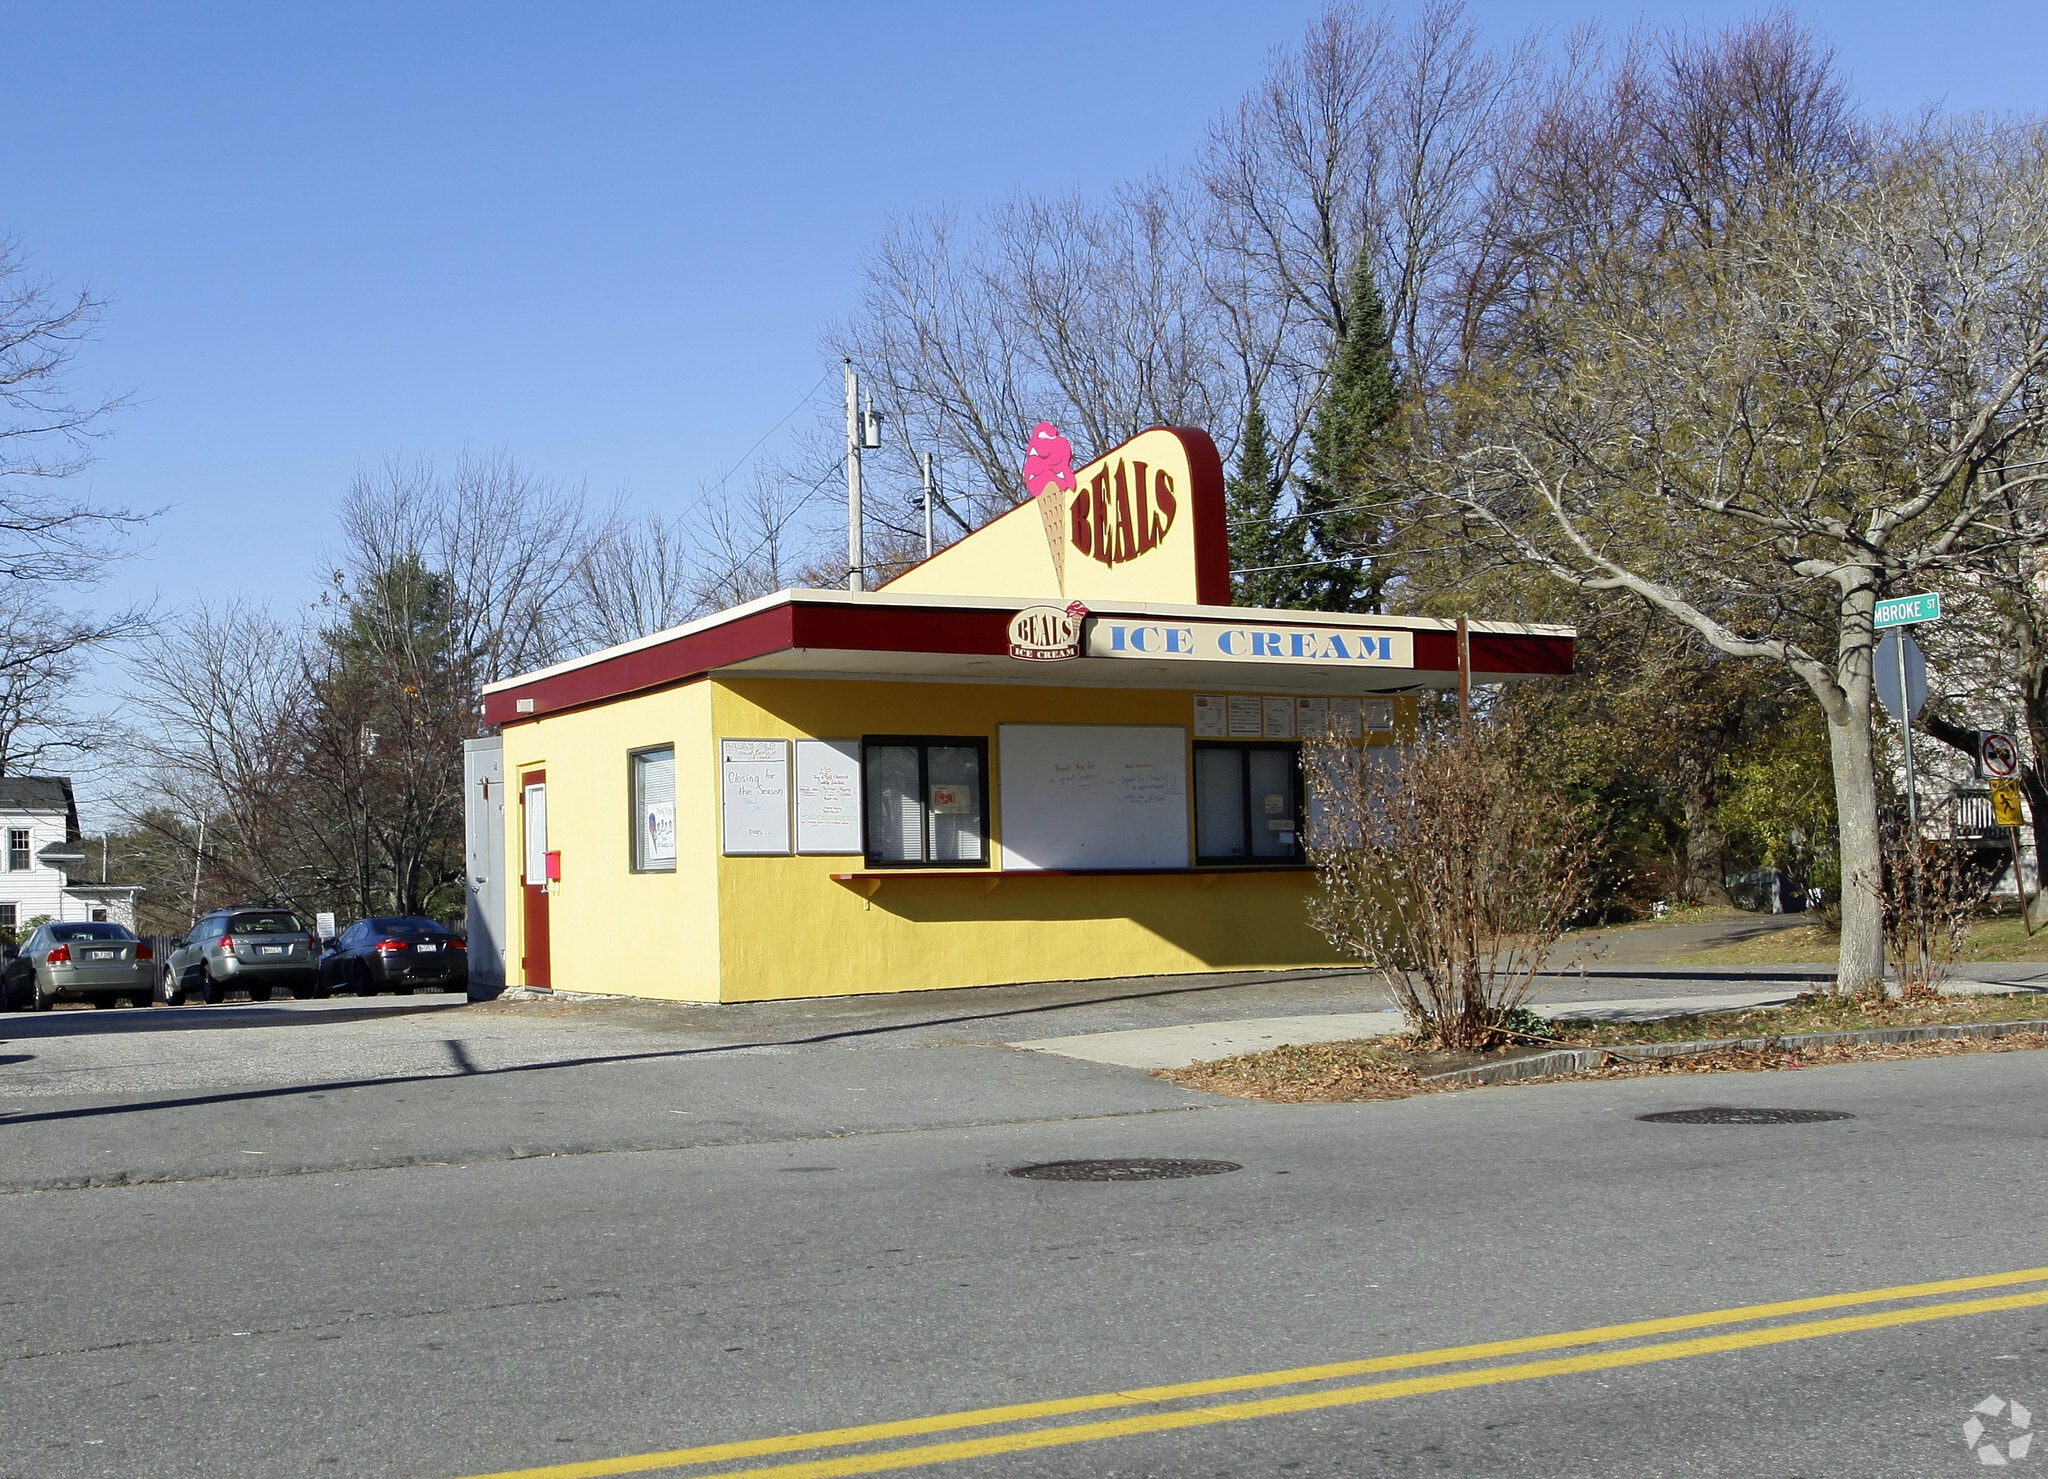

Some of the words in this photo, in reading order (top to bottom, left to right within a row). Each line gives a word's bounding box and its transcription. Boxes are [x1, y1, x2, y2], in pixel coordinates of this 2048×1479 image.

[1069, 457, 1177, 571] BEALS
[1926, 598, 1936, 610] ST
[1017, 613, 1072, 648] BEALS
[1014, 647, 1033, 658] ICE
[1036, 646, 1075, 659] CREAM
[1109, 625, 1195, 655] ICE
[1217, 629, 1394, 661] CREAM
[728, 771, 760, 789] Closing
[765, 768, 776, 779] for
[738, 785, 752, 796] the
[757, 784, 784, 796] Season
